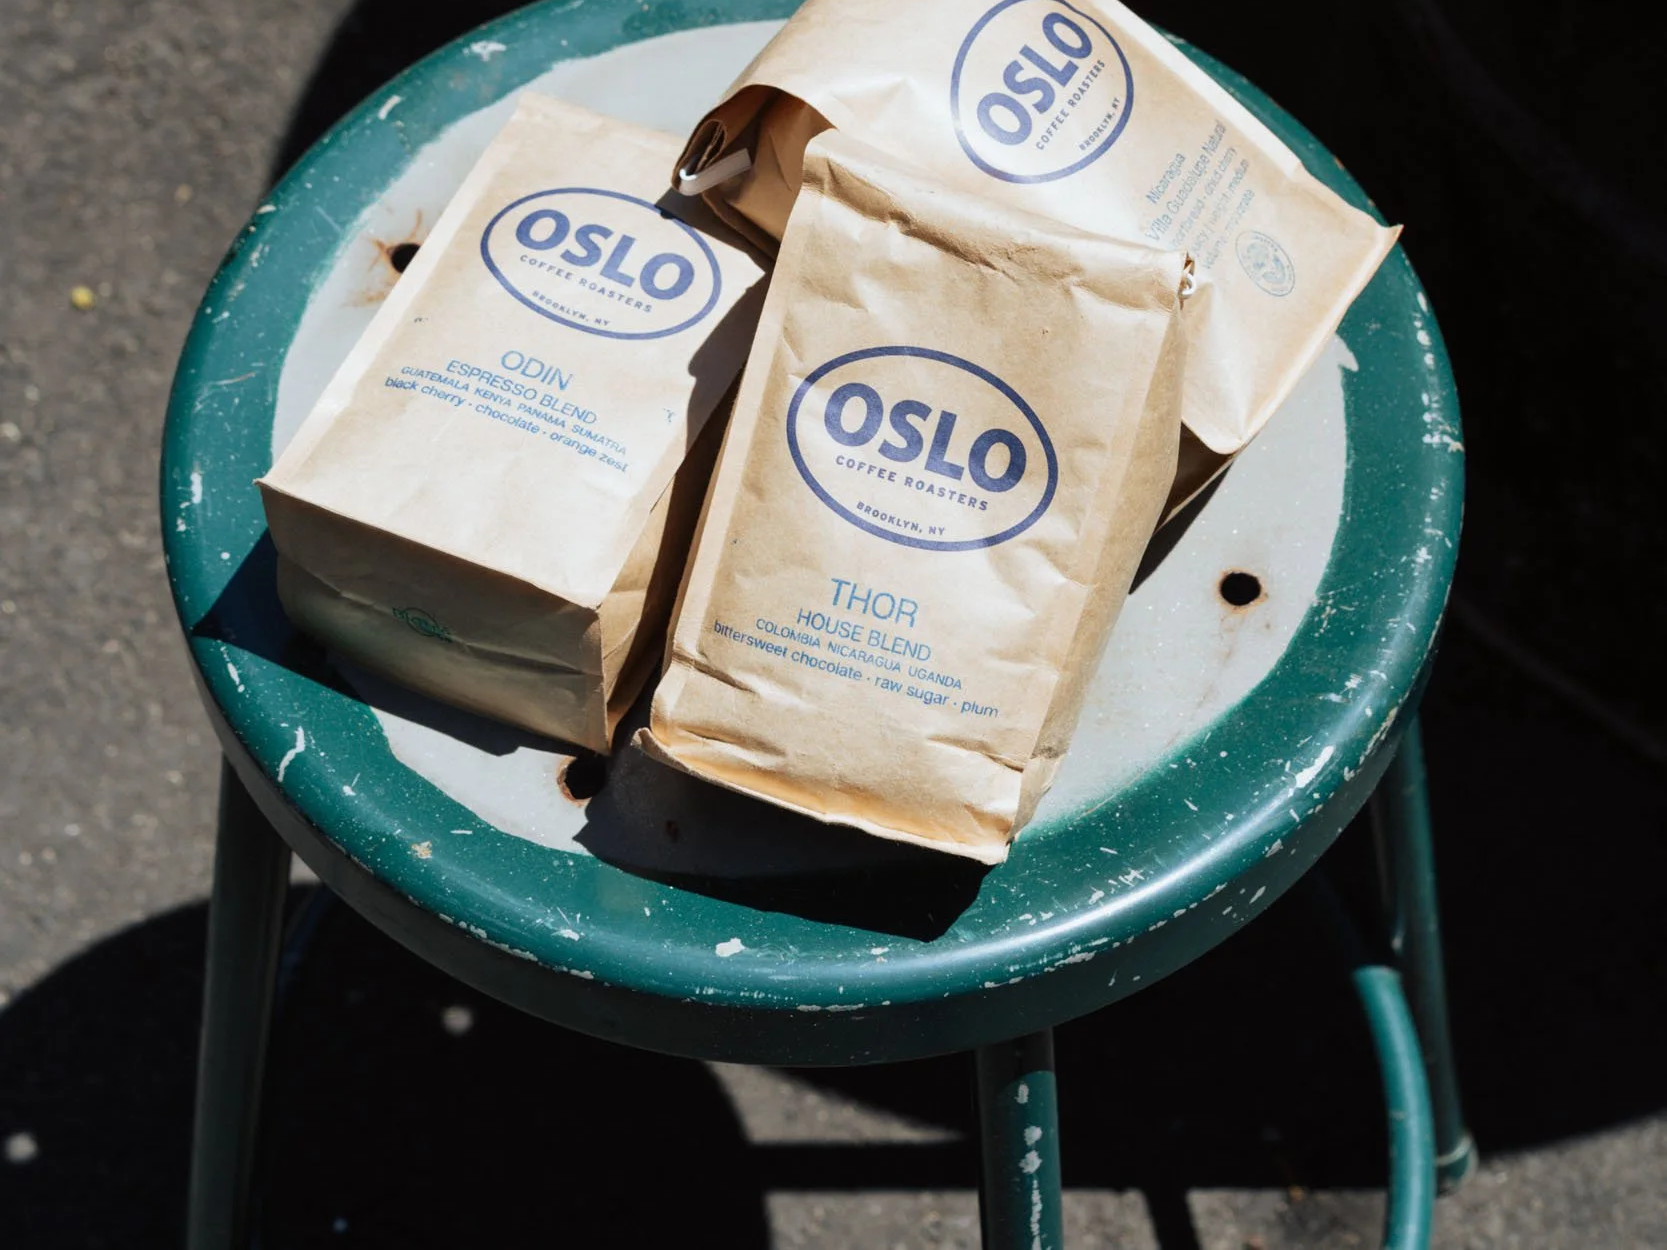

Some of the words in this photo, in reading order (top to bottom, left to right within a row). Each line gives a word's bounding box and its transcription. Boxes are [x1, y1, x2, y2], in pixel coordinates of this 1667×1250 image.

[976, 12, 1093, 146] OSLO
[1035, 109, 1070, 150] COFFEE
[1067, 59, 1105, 108] ROASTERS
[1111, 96, 1120, 110] NY
[1144, 213, 1173, 241] Villa
[1166, 154, 1210, 215] Guadalupe
[1201, 119, 1227, 156] Natural
[1145, 153, 1186, 204] Nicaragua
[515, 208, 695, 301] OSLO
[520, 254, 574, 280] COFFEE
[579, 277, 653, 313] ROASTERS
[594, 317, 611, 327] NY
[446, 359, 538, 401] ESPRESSO
[539, 393, 598, 425] BLEND
[501, 350, 574, 391] ODIN
[384, 376, 419, 391] black
[420, 385, 466, 407] cherry
[474, 403, 541, 434] chocolate
[549, 432, 598, 458] orange
[598, 453, 629, 473] zest
[400, 366, 470, 392] GUATEMALA
[473, 386, 512, 408] KENYA
[517, 402, 567, 429] PANAMA
[571, 423, 628, 456] SUMATRA
[823, 382, 1027, 494] OSLO
[835, 454, 897, 483] COFFEE
[903, 476, 989, 512] ROASTERS
[856, 501, 923, 534] BROOKLYN,
[928, 525, 946, 536] NY
[796, 607, 864, 643] HOUSE
[867, 629, 932, 662] BLEND
[831, 577, 919, 628] THOR
[713, 619, 789, 658] bittersweet
[791, 650, 863, 681] chocolate
[874, 675, 903, 693] raw
[906, 685, 950, 705] sugar
[960, 700, 999, 719] plum
[756, 618, 821, 649] COLOMBIA
[827, 641, 902, 673] NICARAGUA
[908, 665, 962, 690] UGANDA
